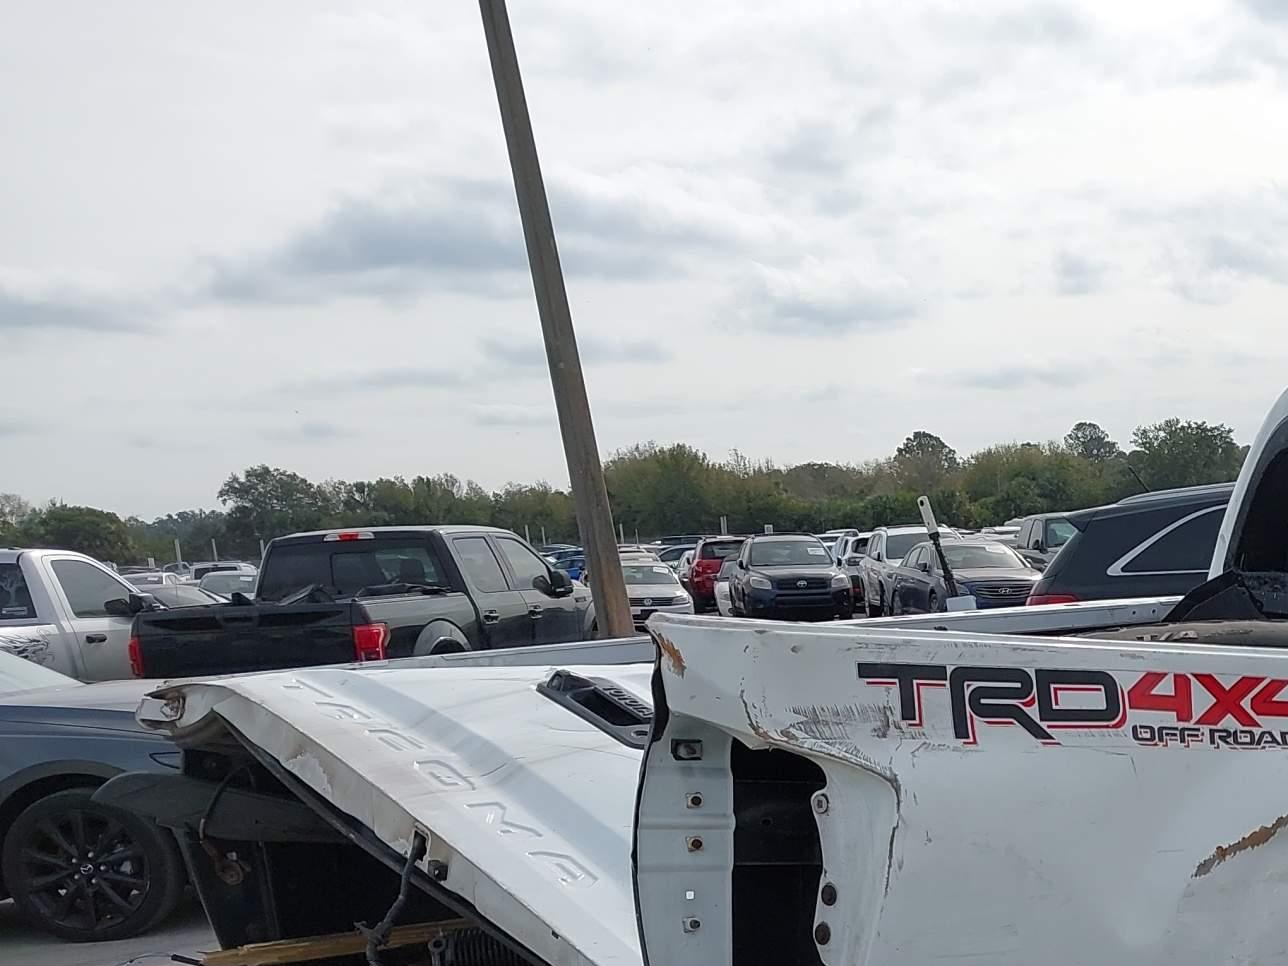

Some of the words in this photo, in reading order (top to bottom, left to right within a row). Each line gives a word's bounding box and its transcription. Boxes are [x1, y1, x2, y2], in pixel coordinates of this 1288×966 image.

[602, 686, 654, 717] TOYOTA
[857, 662, 1127, 745] TRD
[1132, 724, 1204, 747] OFF
